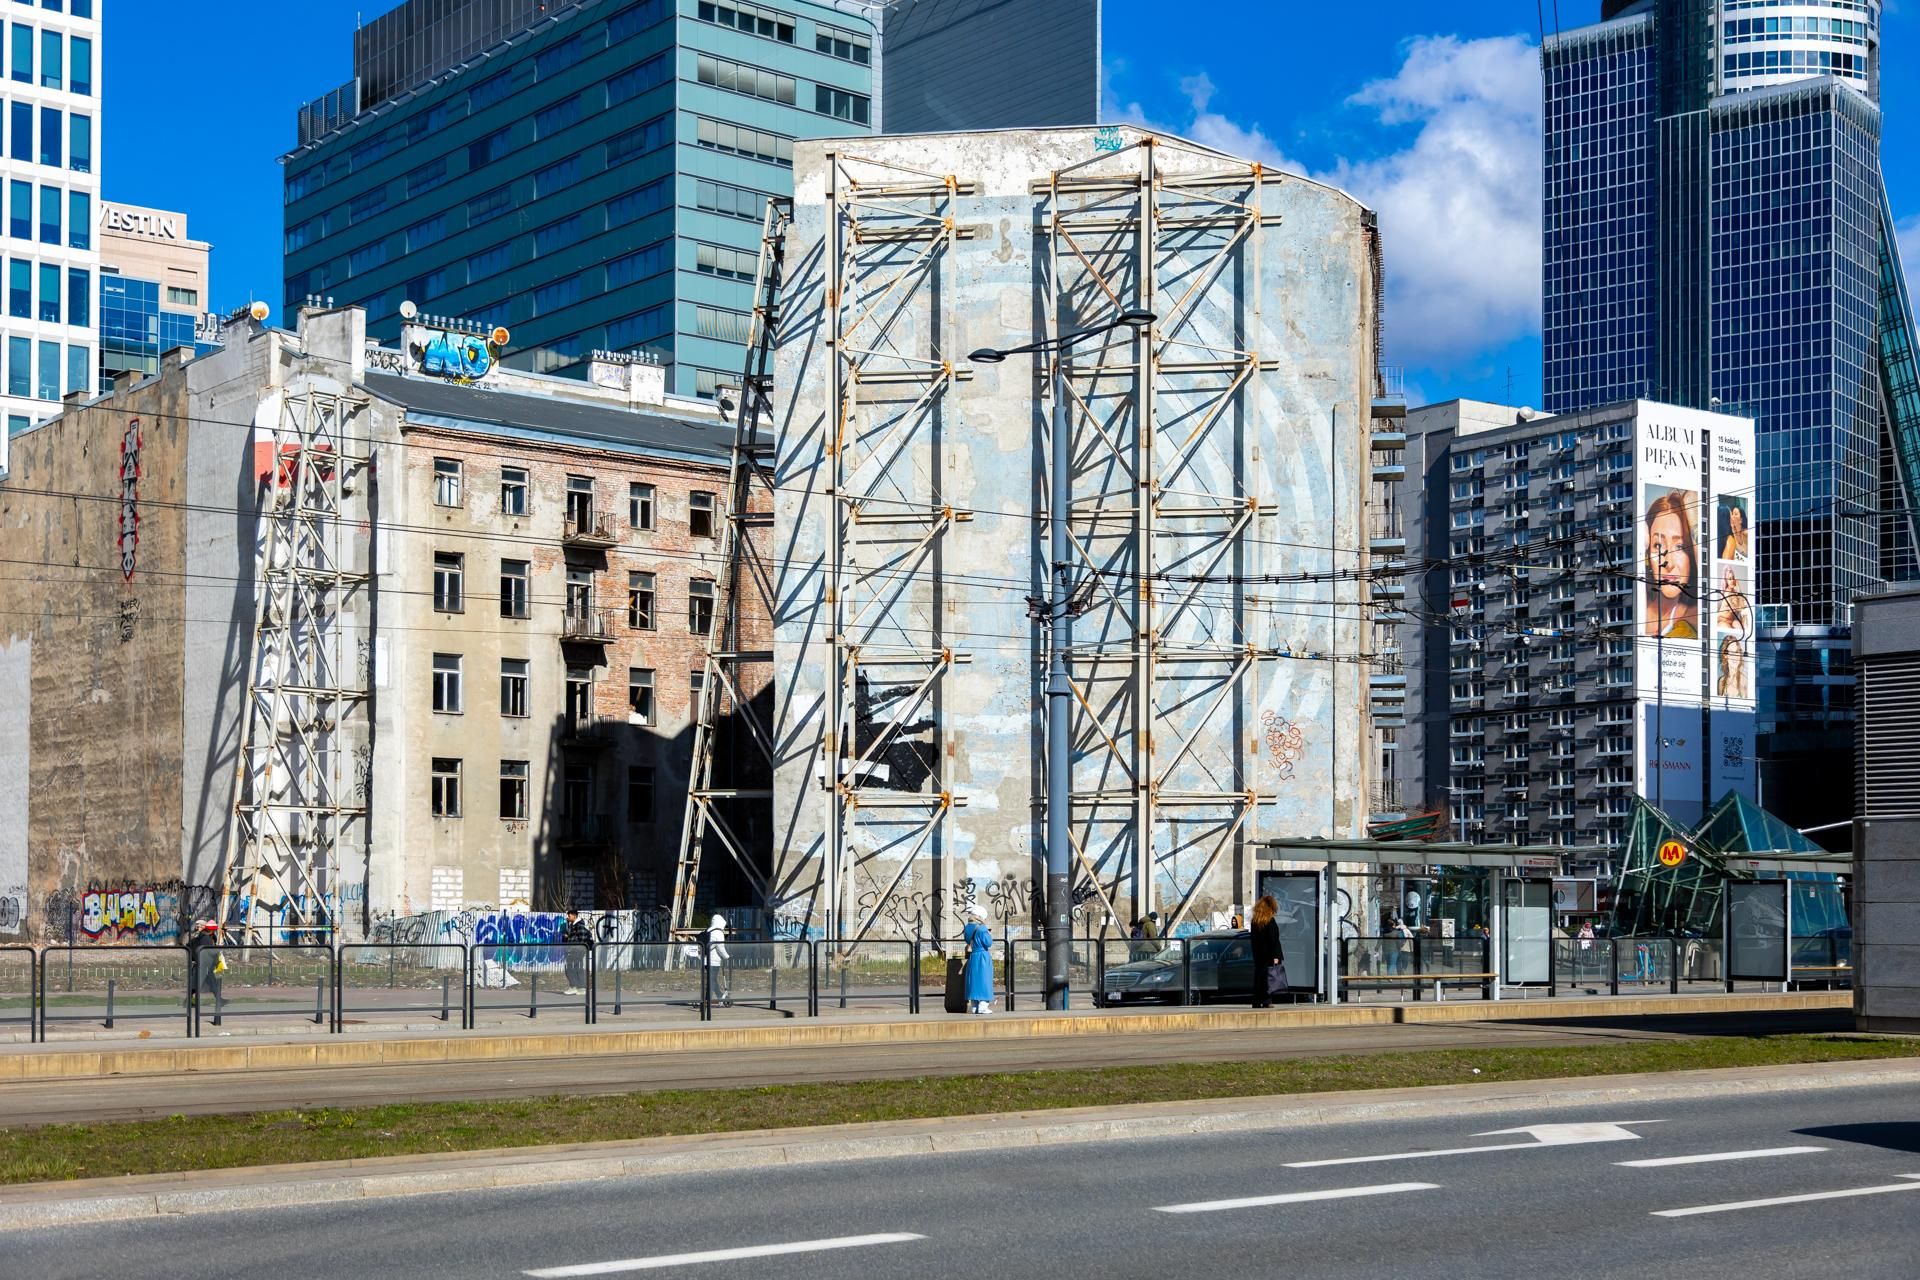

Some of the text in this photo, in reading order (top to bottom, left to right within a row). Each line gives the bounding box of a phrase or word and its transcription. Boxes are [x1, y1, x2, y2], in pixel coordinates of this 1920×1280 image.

[1646, 424, 1695, 446] ALBUM
[1725, 436, 1742, 446] kobiet,
[1645, 447, 1697, 470] PIĘKNA
